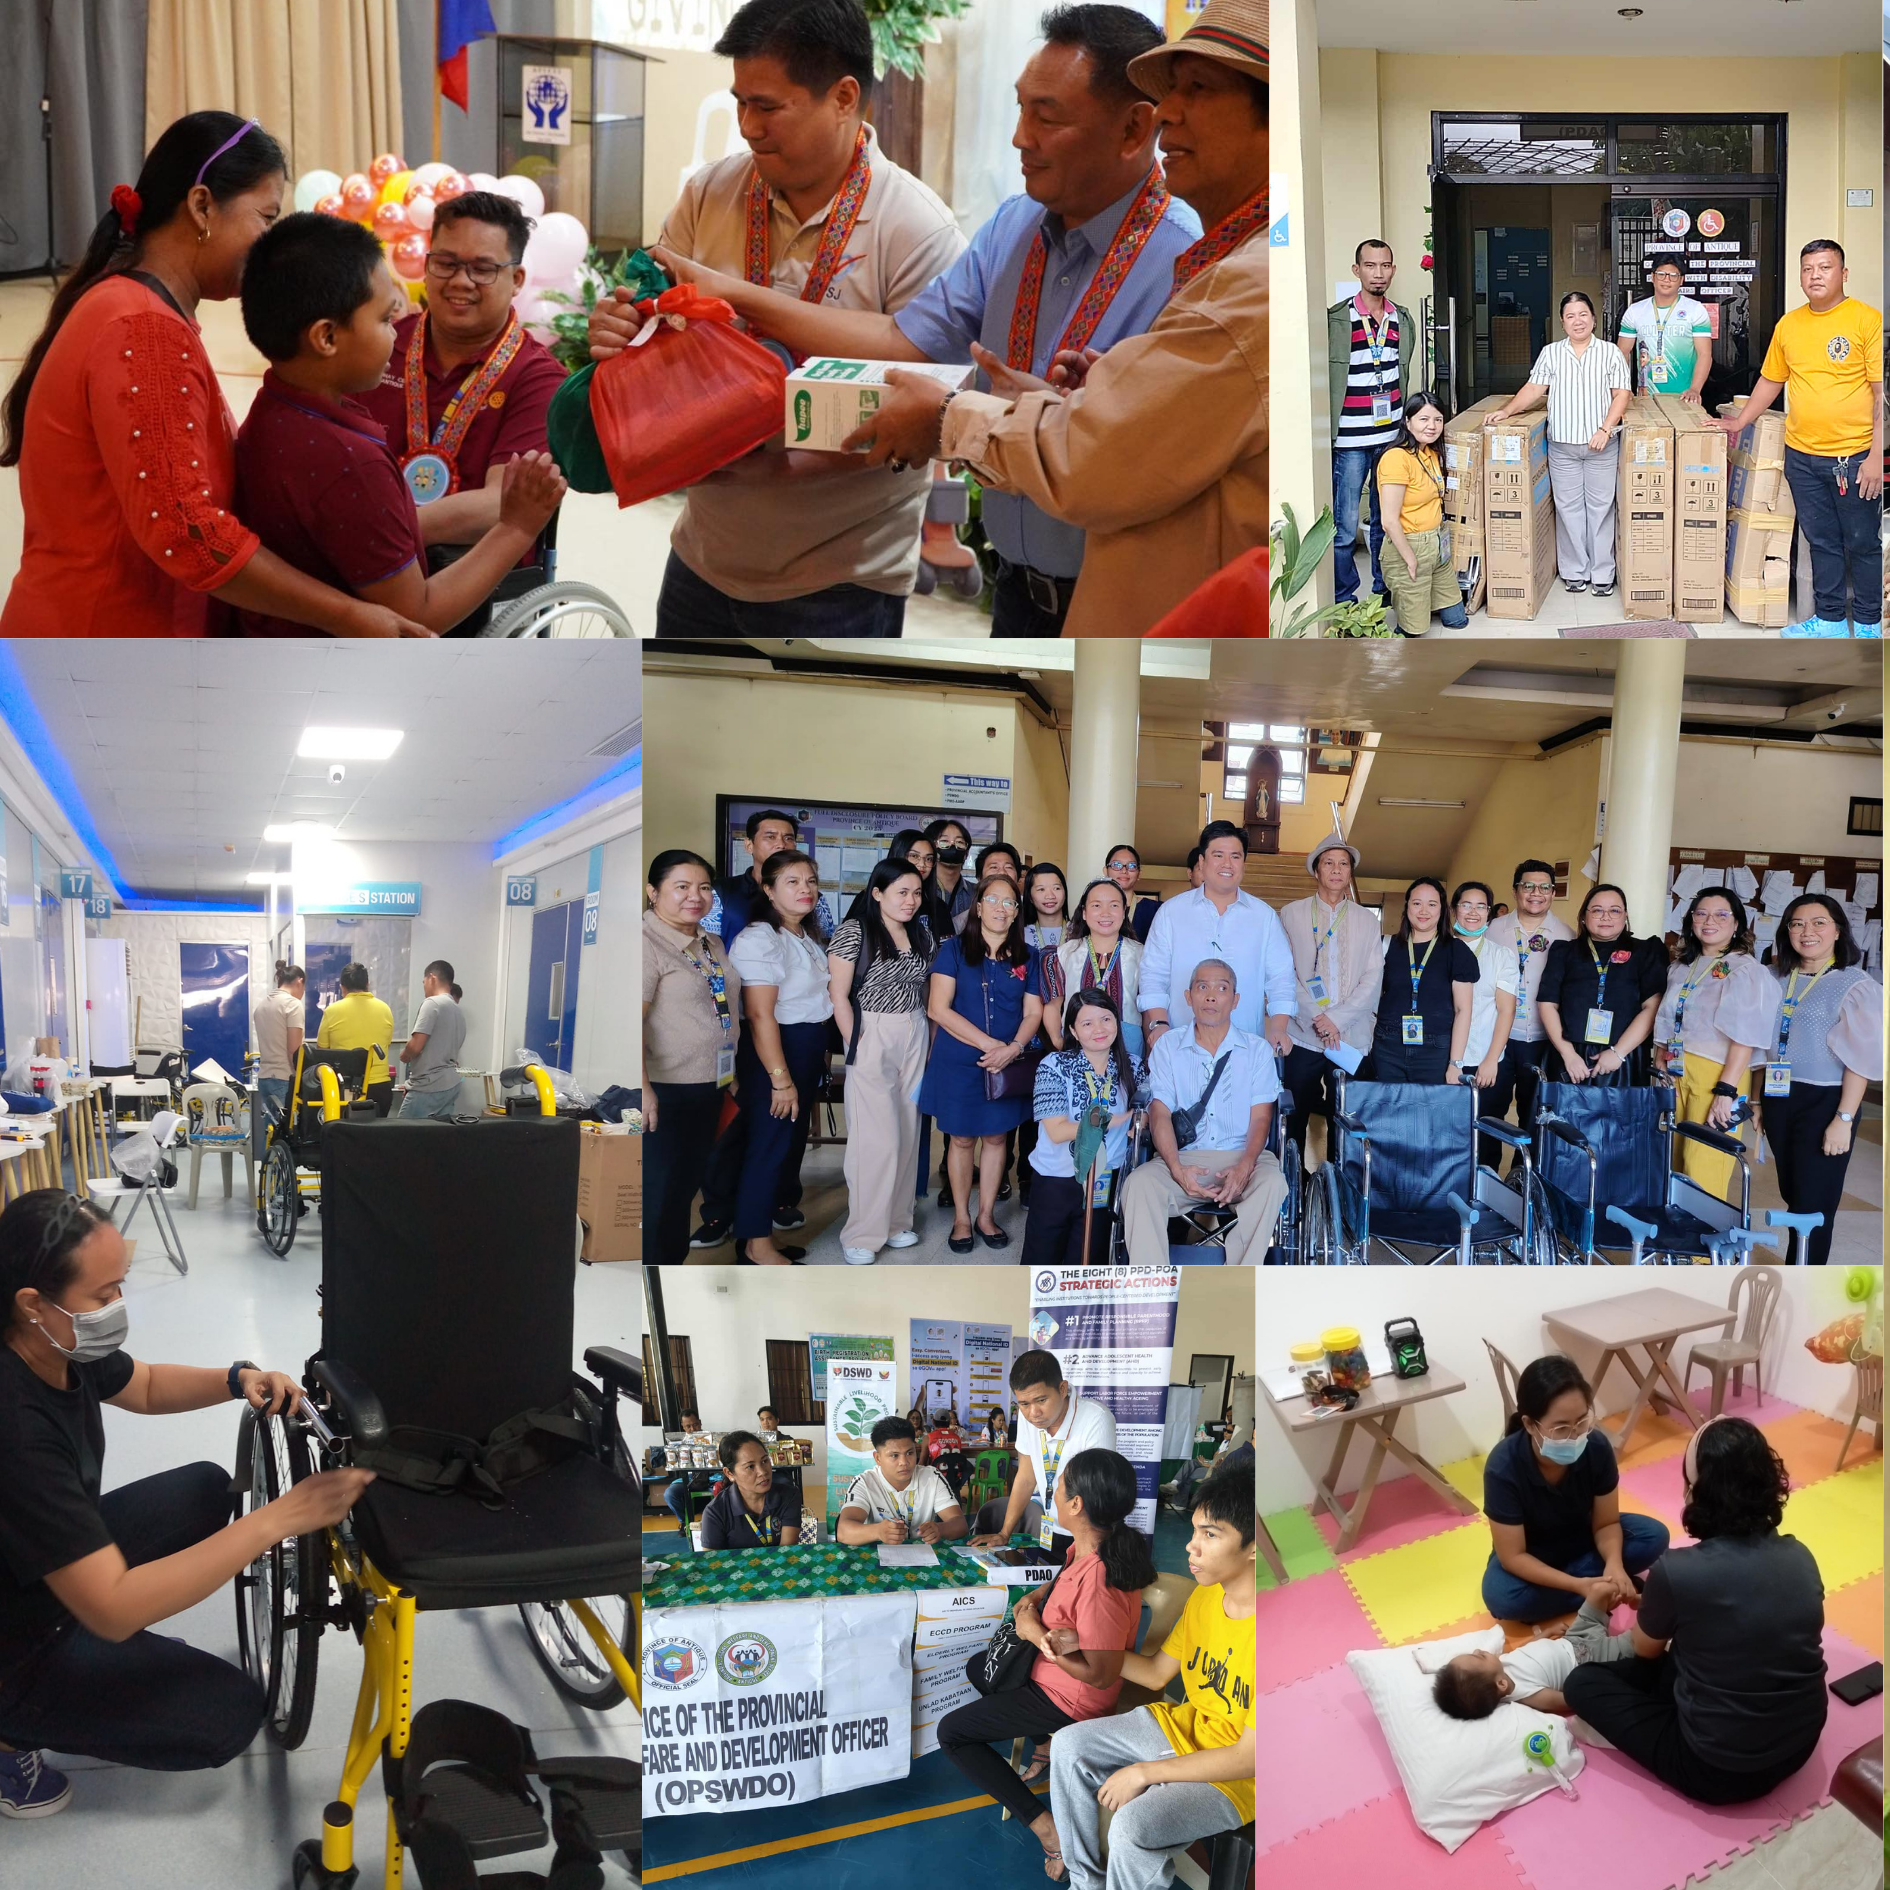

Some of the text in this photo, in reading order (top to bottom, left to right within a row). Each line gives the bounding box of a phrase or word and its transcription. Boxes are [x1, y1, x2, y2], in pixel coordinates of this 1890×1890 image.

[1646, 242, 1739, 252] PROVINCE OF ANTIQUE
[826, 286, 842, 300] SJ
[1640, 324, 1686, 337] CLUTER
[797, 398, 806, 431] hapee
[1512, 490, 1518, 498] 3
[1654, 491, 1660, 499] 3
[1708, 499, 1714, 507] 3
[969, 776, 1009, 789] This way to
[826, 810, 871, 818] DISCLOSURE
[894, 813, 918, 821] BOARD
[832, 817, 862, 825] PROVINCE
[872, 819, 900, 827] ANTIQUE
[69, 875, 86, 893] 17
[370, 892, 416, 904] STATION
[509, 883, 532, 901] 08
[90, 898, 106, 914] 18
[585, 909, 598, 933] 08
[1061, 1265, 1178, 1279] THE EIGHT (8) PPD-POA
[1059, 1276, 1178, 1292] STRATEGIC ACTIONS
[1065, 1315, 1079, 1327] #1
[1063, 1354, 1079, 1365] #2
[843, 1367, 872, 1378] DSWD
[849, 1389, 882, 1404] LIVELIHOOD
[834, 1395, 848, 1431] SUSTAINABLE
[1024, 1569, 1053, 1582] PDAO
[952, 1596, 976, 1606] AICS
[929, 1622, 991, 1637] ECCD PROGRAM
[642, 1638, 666, 1665] PROVINCE
[681, 1638, 706, 1662] ANTIQUE
[926, 1642, 985, 1658] ELDERLY WELFARE
[939, 1650, 970, 1660] PROGRAM
[920, 1664, 967, 1685] FAMILY WELFA
[930, 1673, 961, 1688] PROGRAM
[651, 1677, 699, 1690] OFFICIAL SEAL
[918, 1687, 972, 1712] UNLAD KABATAAN
[931, 1698, 961, 1715] PROGRAM
[643, 1690, 828, 1739] ICE OF THE PROVINCIAL
[685, 1740, 718, 1773] AND
[720, 1724, 829, 1771] DEVELOPMENT
[831, 1716, 889, 1755] OFFICER
[655, 1770, 796, 1814] (OPSWDO)
